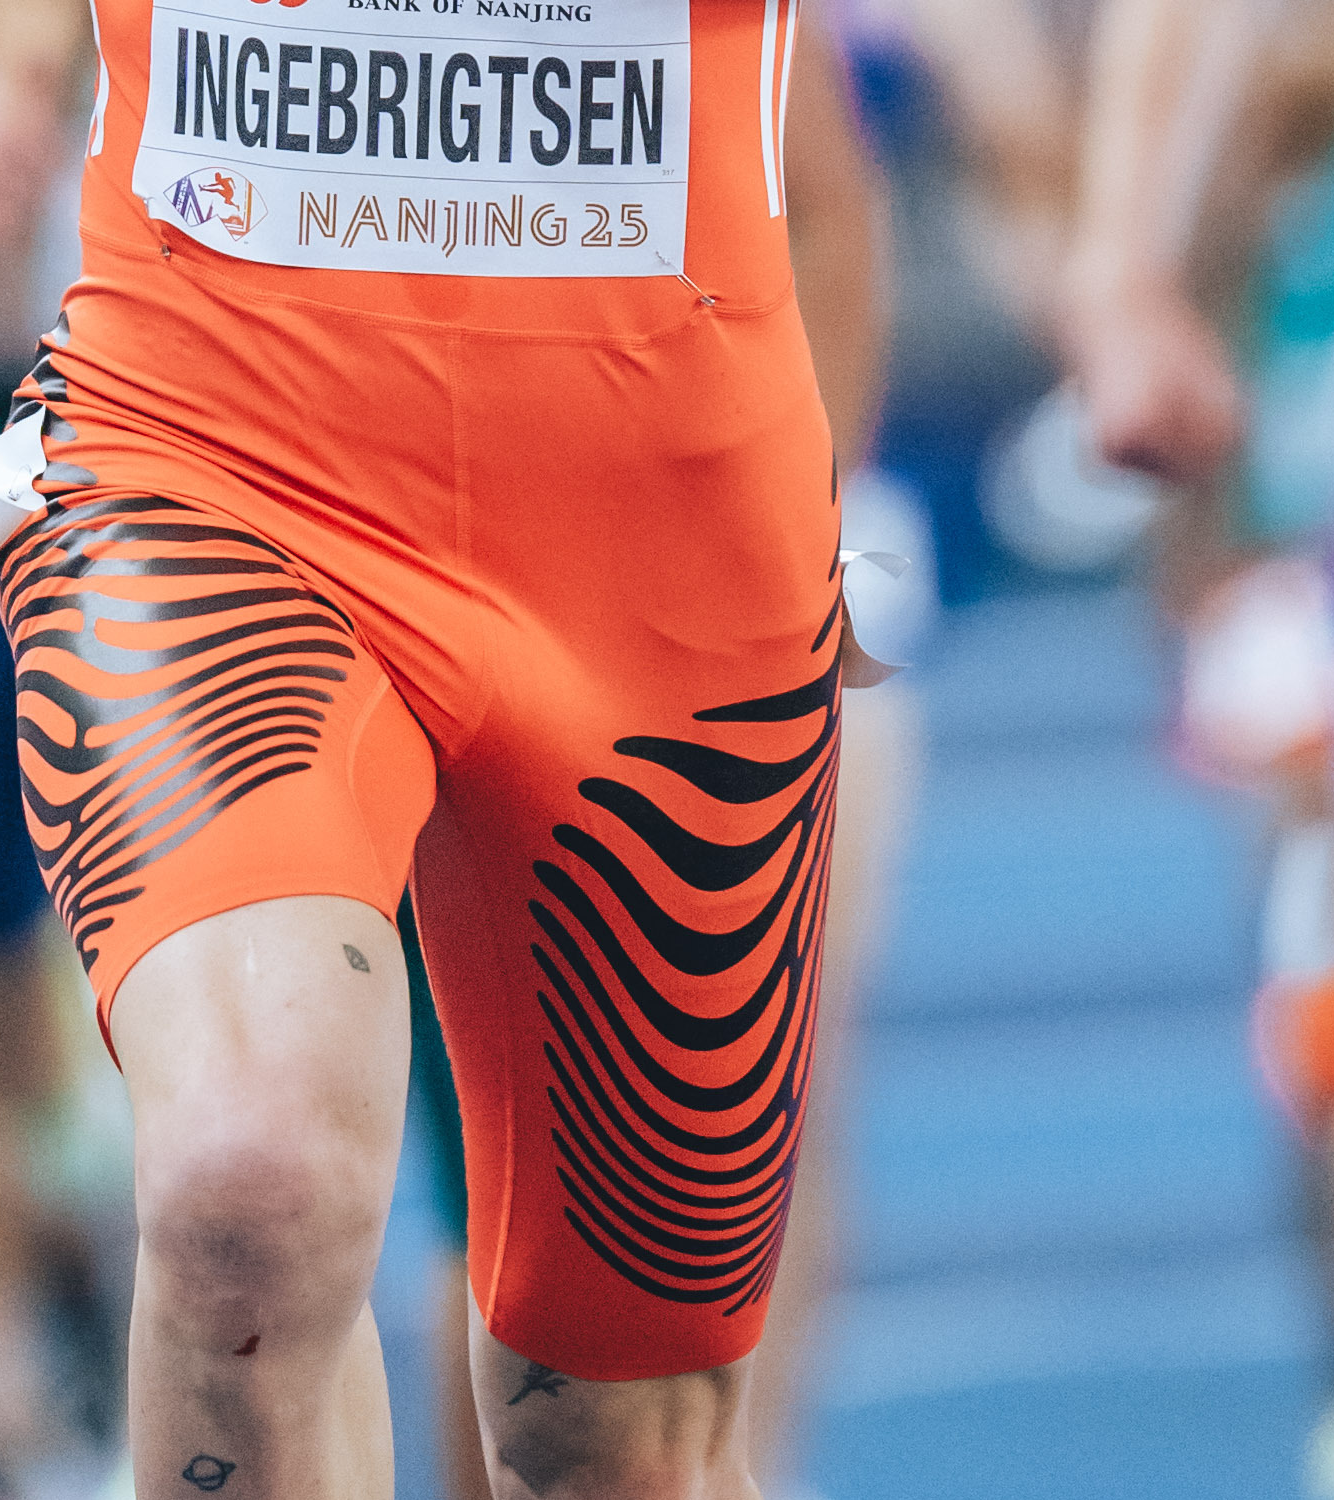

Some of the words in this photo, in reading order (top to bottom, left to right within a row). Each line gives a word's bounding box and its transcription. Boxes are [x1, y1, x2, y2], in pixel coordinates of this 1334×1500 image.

[476, 0, 592, 23] NANJING
[174, 27, 665, 167] INGEBRIGTSEN
[299, 192, 568, 258] NANJING
[581, 203, 649, 247] 25
